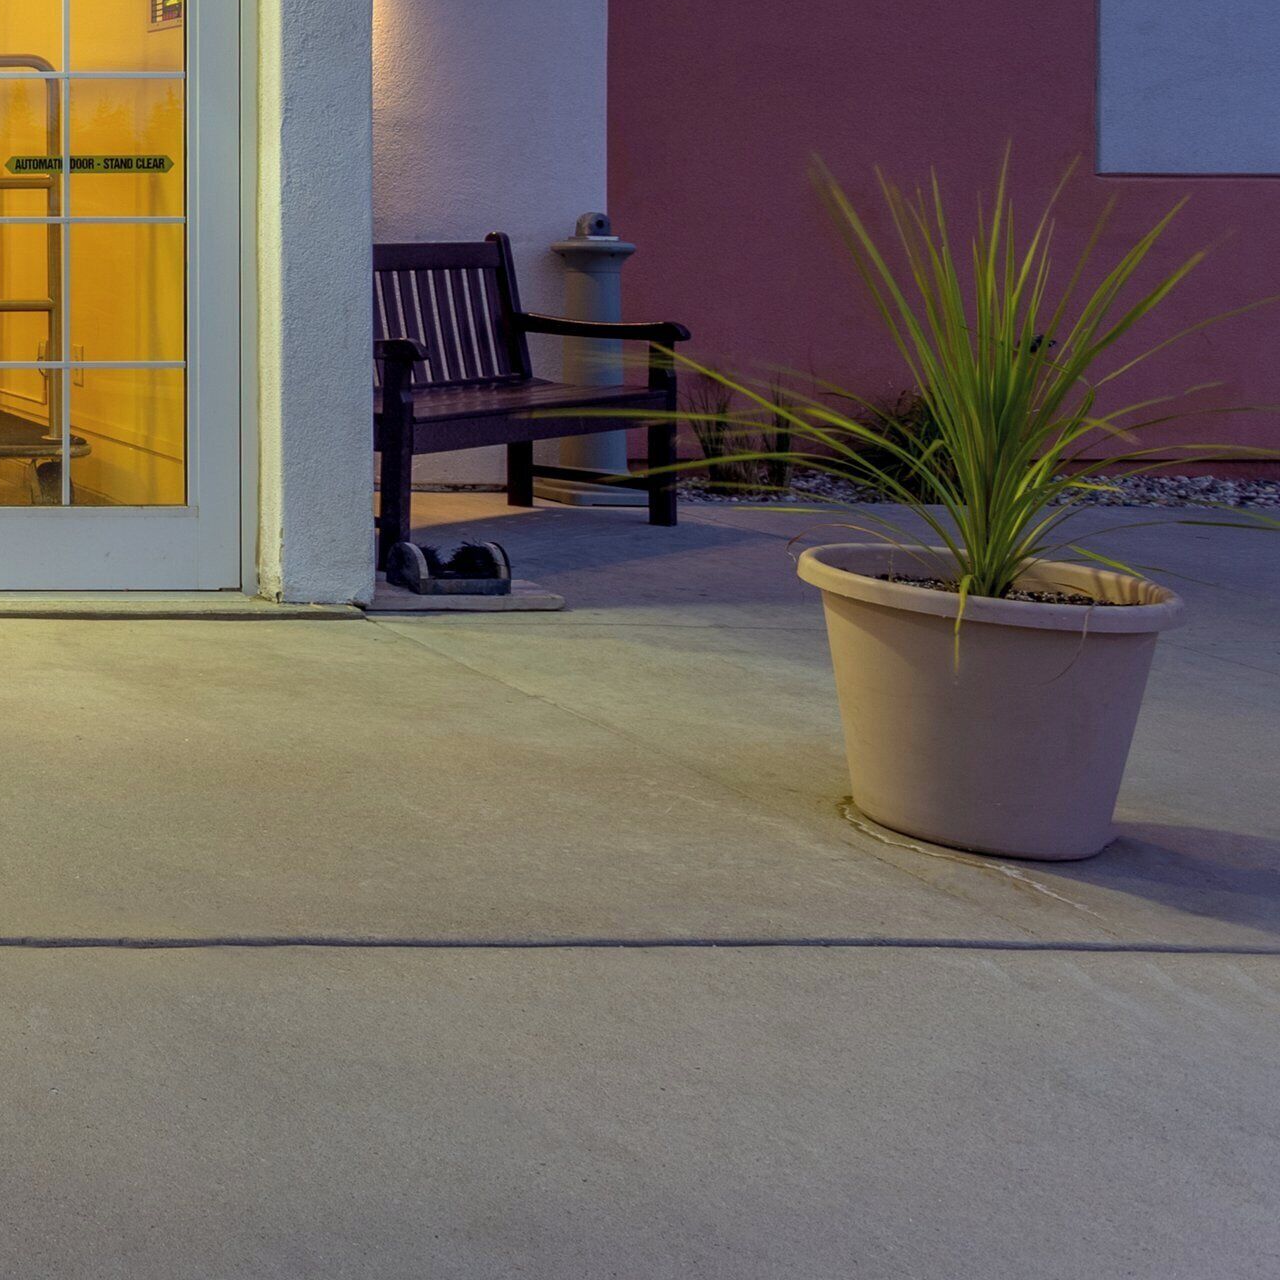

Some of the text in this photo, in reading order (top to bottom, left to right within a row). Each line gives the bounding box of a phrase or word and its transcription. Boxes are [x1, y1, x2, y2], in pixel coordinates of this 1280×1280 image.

[15, 158, 63, 169] AUTOMATI
[70, 158, 95, 169] DOOR
[104, 158, 133, 169] STAND
[135, 158, 165, 169] CLEAR
